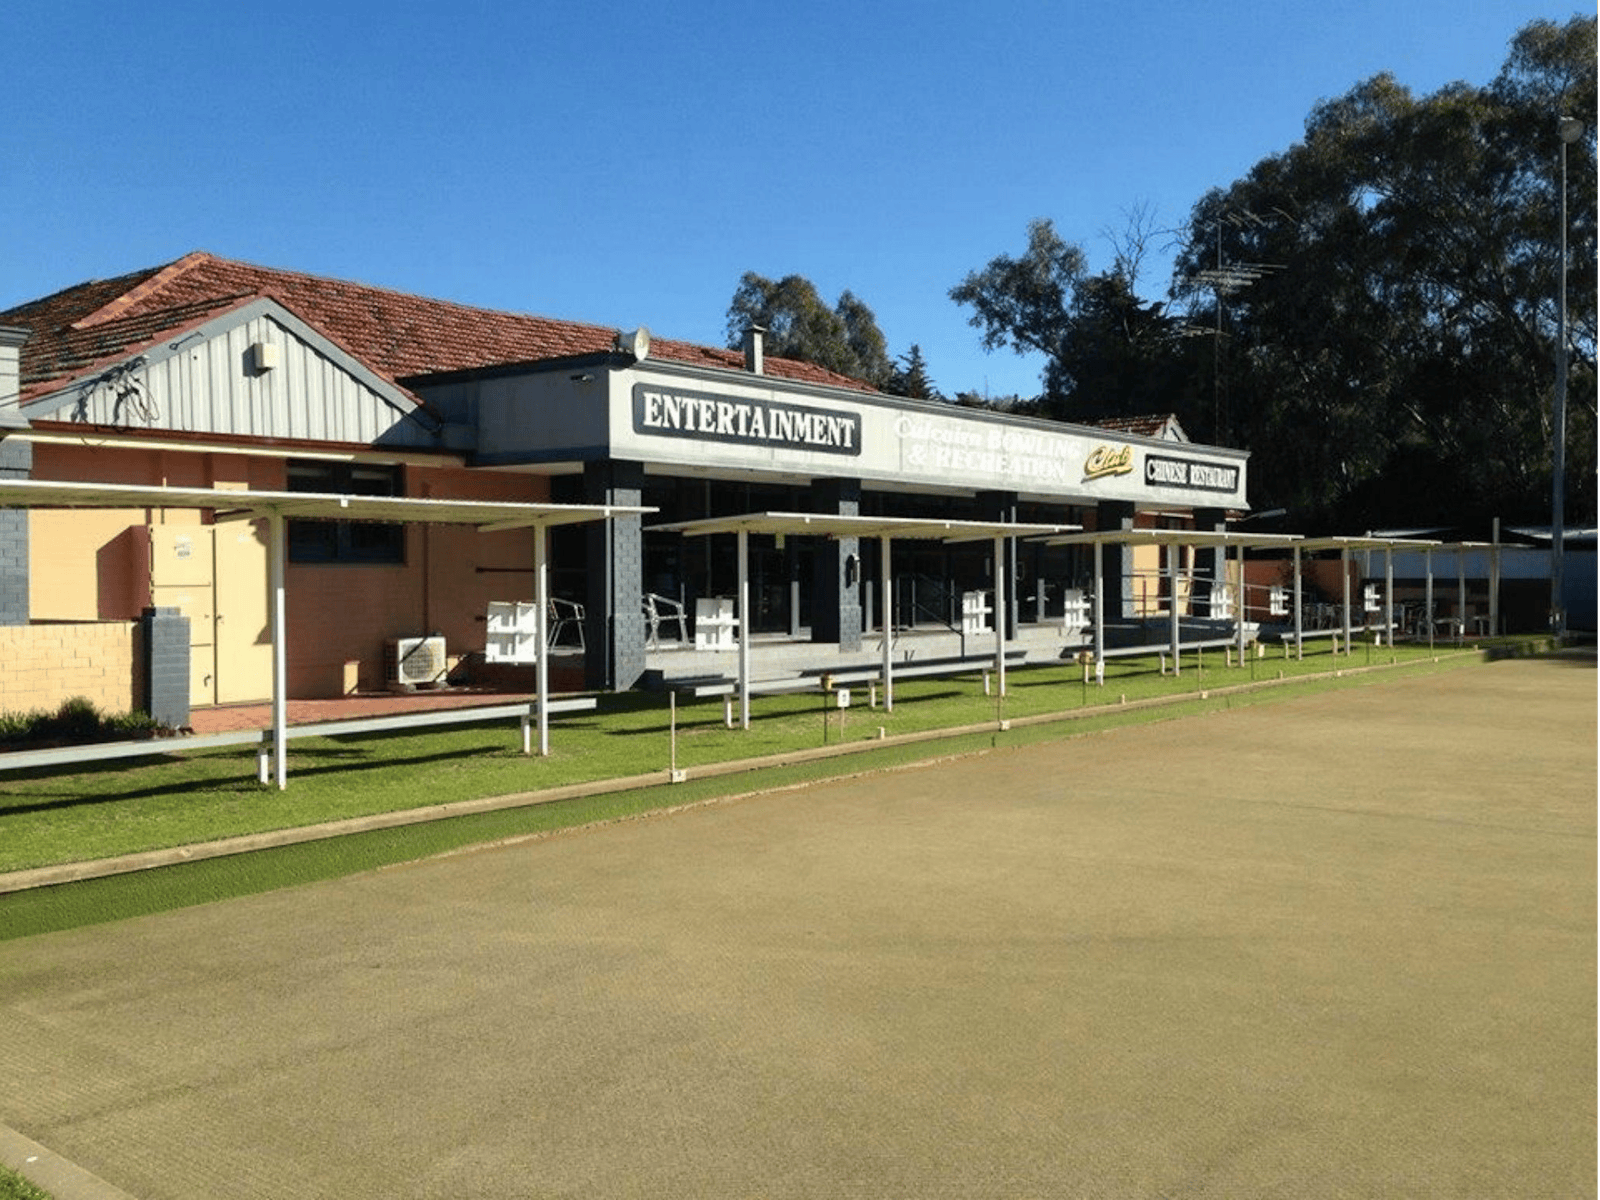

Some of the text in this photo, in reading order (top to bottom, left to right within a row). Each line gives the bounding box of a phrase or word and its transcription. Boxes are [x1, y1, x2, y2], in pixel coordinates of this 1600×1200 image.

[642, 391, 856, 448] ENTERTAINMENT
[987, 429, 1082, 459] BOWLING
[907, 444, 1066, 479] & RECREATION
[1084, 445, 1132, 476] Club
[1146, 458, 1237, 490] CHINESE RESTAURANT
